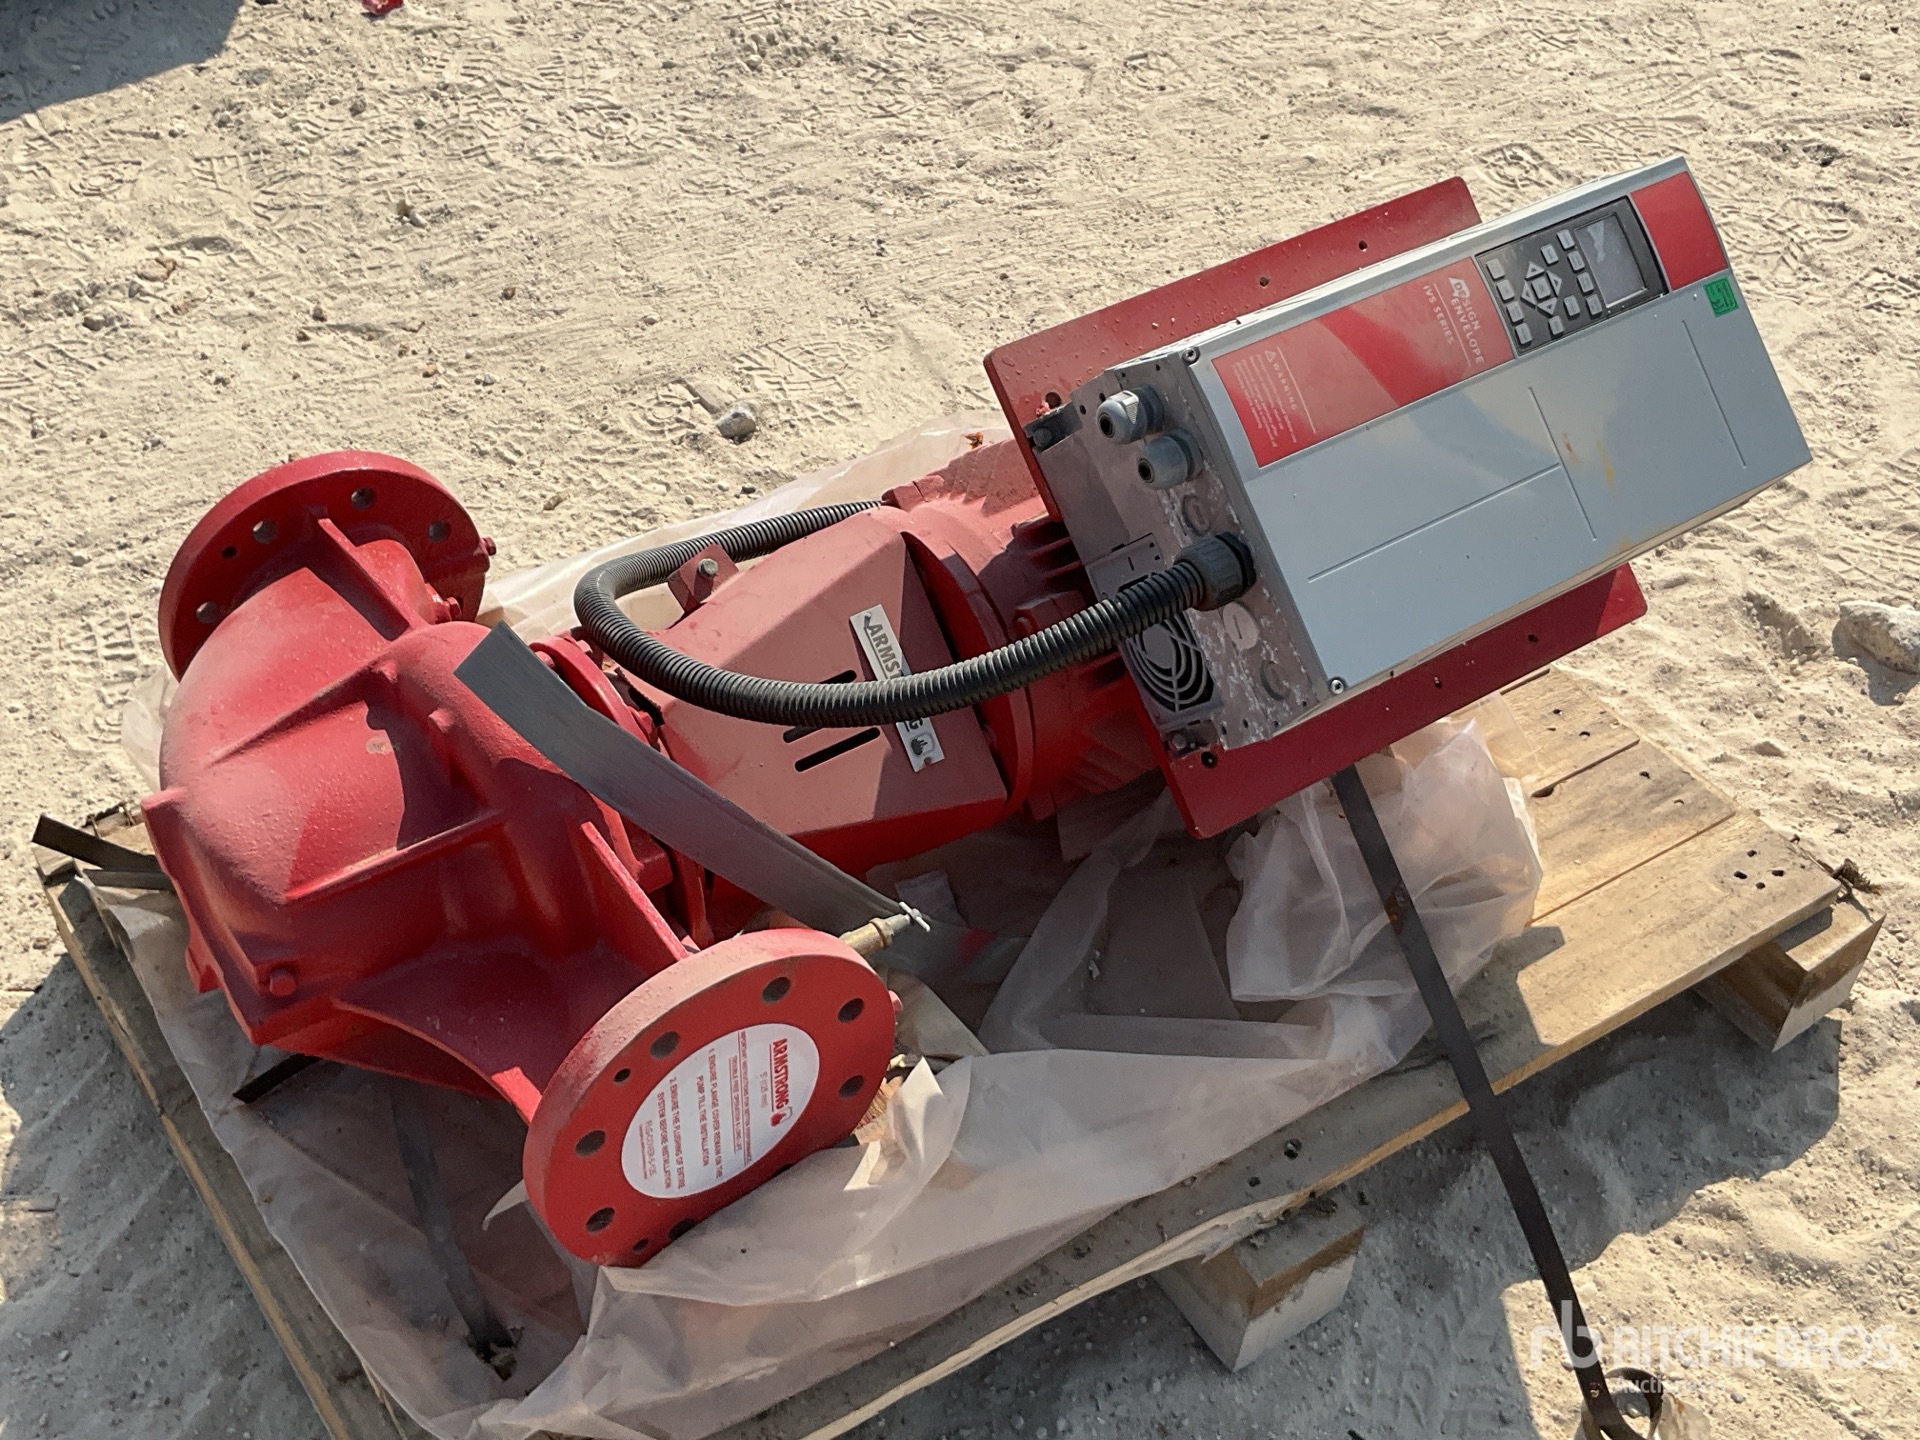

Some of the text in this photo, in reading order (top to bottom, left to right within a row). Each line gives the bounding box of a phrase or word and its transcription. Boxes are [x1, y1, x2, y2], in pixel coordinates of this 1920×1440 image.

[1423, 284, 1455, 345] IVS SERIES
[1451, 297, 1485, 364] ENVELOPE
[1453, 280, 1482, 331] DESIGN
[1273, 362, 1297, 411] WARNING
[866, 622, 924, 730] ARMSTG
[772, 1038, 789, 1109] ARMSTRONG
[657, 1091, 665, 1118] SYSTEM
[663, 1144, 671, 1189] INSTALLATION
[676, 1156, 683, 1166] OF
[716, 1155, 721, 1165] ON
[677, 1166, 685, 1189] ENTIRE
